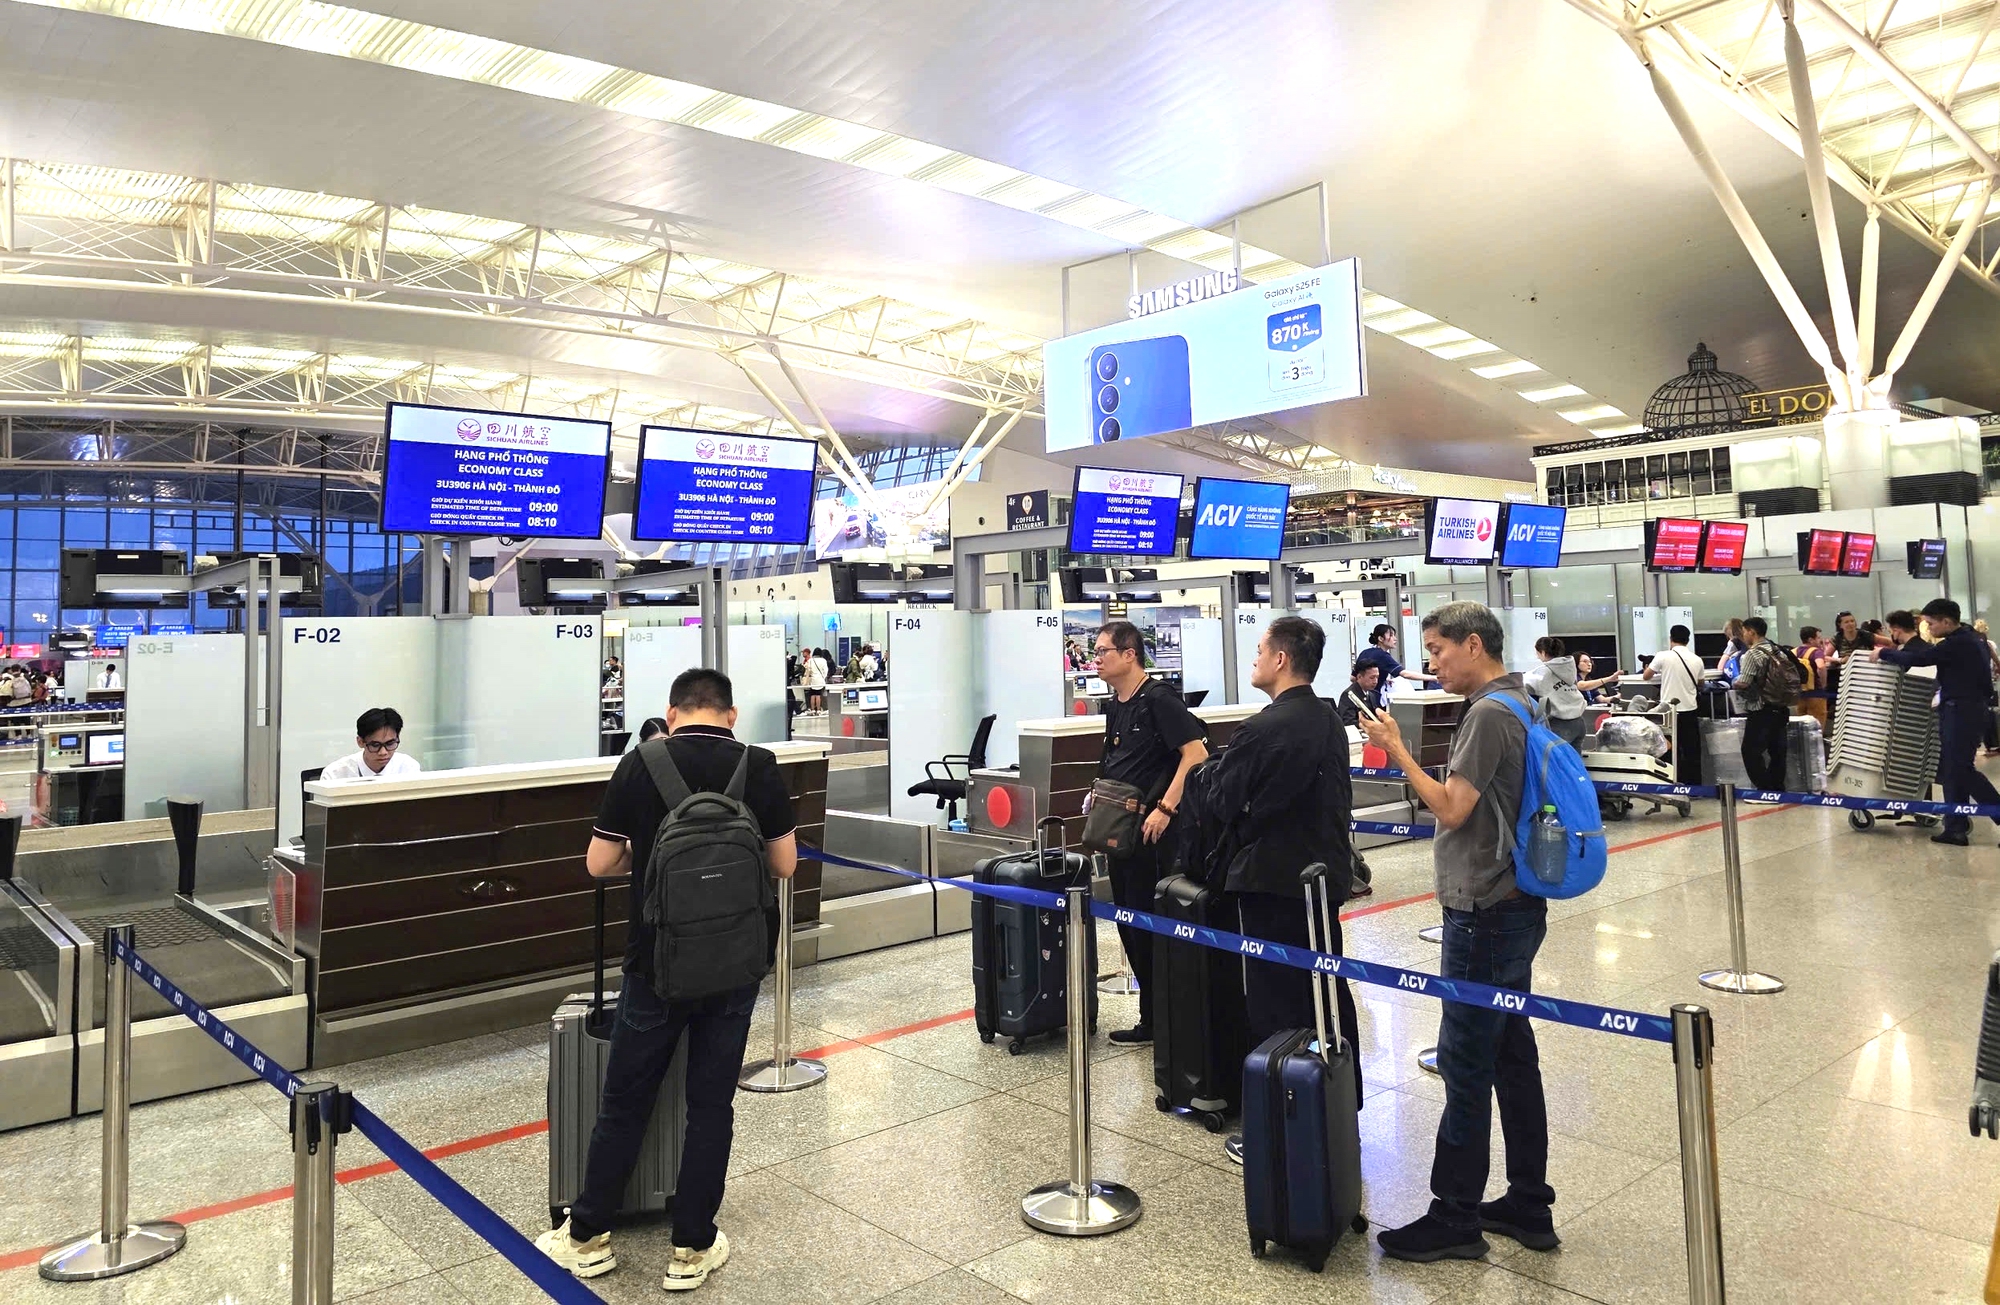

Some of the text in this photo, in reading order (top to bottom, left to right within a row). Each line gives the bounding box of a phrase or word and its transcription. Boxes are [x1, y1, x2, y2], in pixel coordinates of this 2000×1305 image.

[1128, 268, 1237, 319] SAMSUNG
[1264, 277, 1321, 299] Galaxy S25 FE
[1271, 324, 1301, 344] 870
[1291, 366, 1300, 380] 3
[1750, 398, 1772, 415] EL
[486, 436, 549, 446] SICHUAN AIRLINES
[455, 449, 549, 465] HẠNG PHỐ THÔNG
[458, 464, 544, 478] ECONOMY CLASS
[693, 466, 718, 477] HẠNG
[739, 469, 768, 479] THÔNG
[436, 479, 471, 490] 3U3906
[472, 480, 486, 491] HÀ
[488, 482, 507, 493] NỘI
[513, 483, 545, 494] THÀNH
[696, 479, 763, 491] ECONOMY CLASS
[678, 493, 706, 502] 3U3906
[707, 494, 718, 502] HÀ
[739, 496, 764, 505] THÀNH
[1008, 497, 1016, 506] 4F
[529, 502, 558, 512] 09:00
[750, 512, 774, 521] 09:00
[1015, 516, 1035, 524] COFFEE
[1197, 503, 1244, 527] ACV
[527, 517, 557, 527] 08:10
[1012, 521, 1044, 530] RESTAURANT
[1439, 516, 1476, 529] TURKISH
[749, 525, 773, 534] 08:10
[1437, 528, 1475, 540] AIRLINES
[1508, 523, 1536, 542] ACV
[1036, 616, 1058, 628] F-05
[1238, 613, 1256, 625] F-06
[1331, 613, 1347, 623] F-07
[1534, 612, 1546, 621] F-09
[895, 618, 921, 631] F-04
[293, 627, 341, 644] F-02
[556, 624, 593, 639] F-03
[1673, 786, 1691, 794] ACV
[1761, 793, 1781, 801] ACV
[1821, 797, 1843, 805] ACV
[1886, 801, 1909, 810] ACV
[1954, 805, 1979, 814] ACV
[1392, 825, 1410, 834] ACV
[1114, 909, 1135, 924] ACV
[1174, 924, 1196, 939] ACV
[1240, 939, 1265, 956] ACV
[1314, 956, 1341, 972] ACV
[1398, 974, 1428, 991] ACV
[174, 991, 183, 1007] ACV
[1492, 992, 1526, 1011] ACV
[197, 1009, 208, 1027] ACV
[1600, 1013, 1639, 1033] ACV
[224, 1030, 235, 1049] ACV
[253, 1053, 266, 1073] ACV
